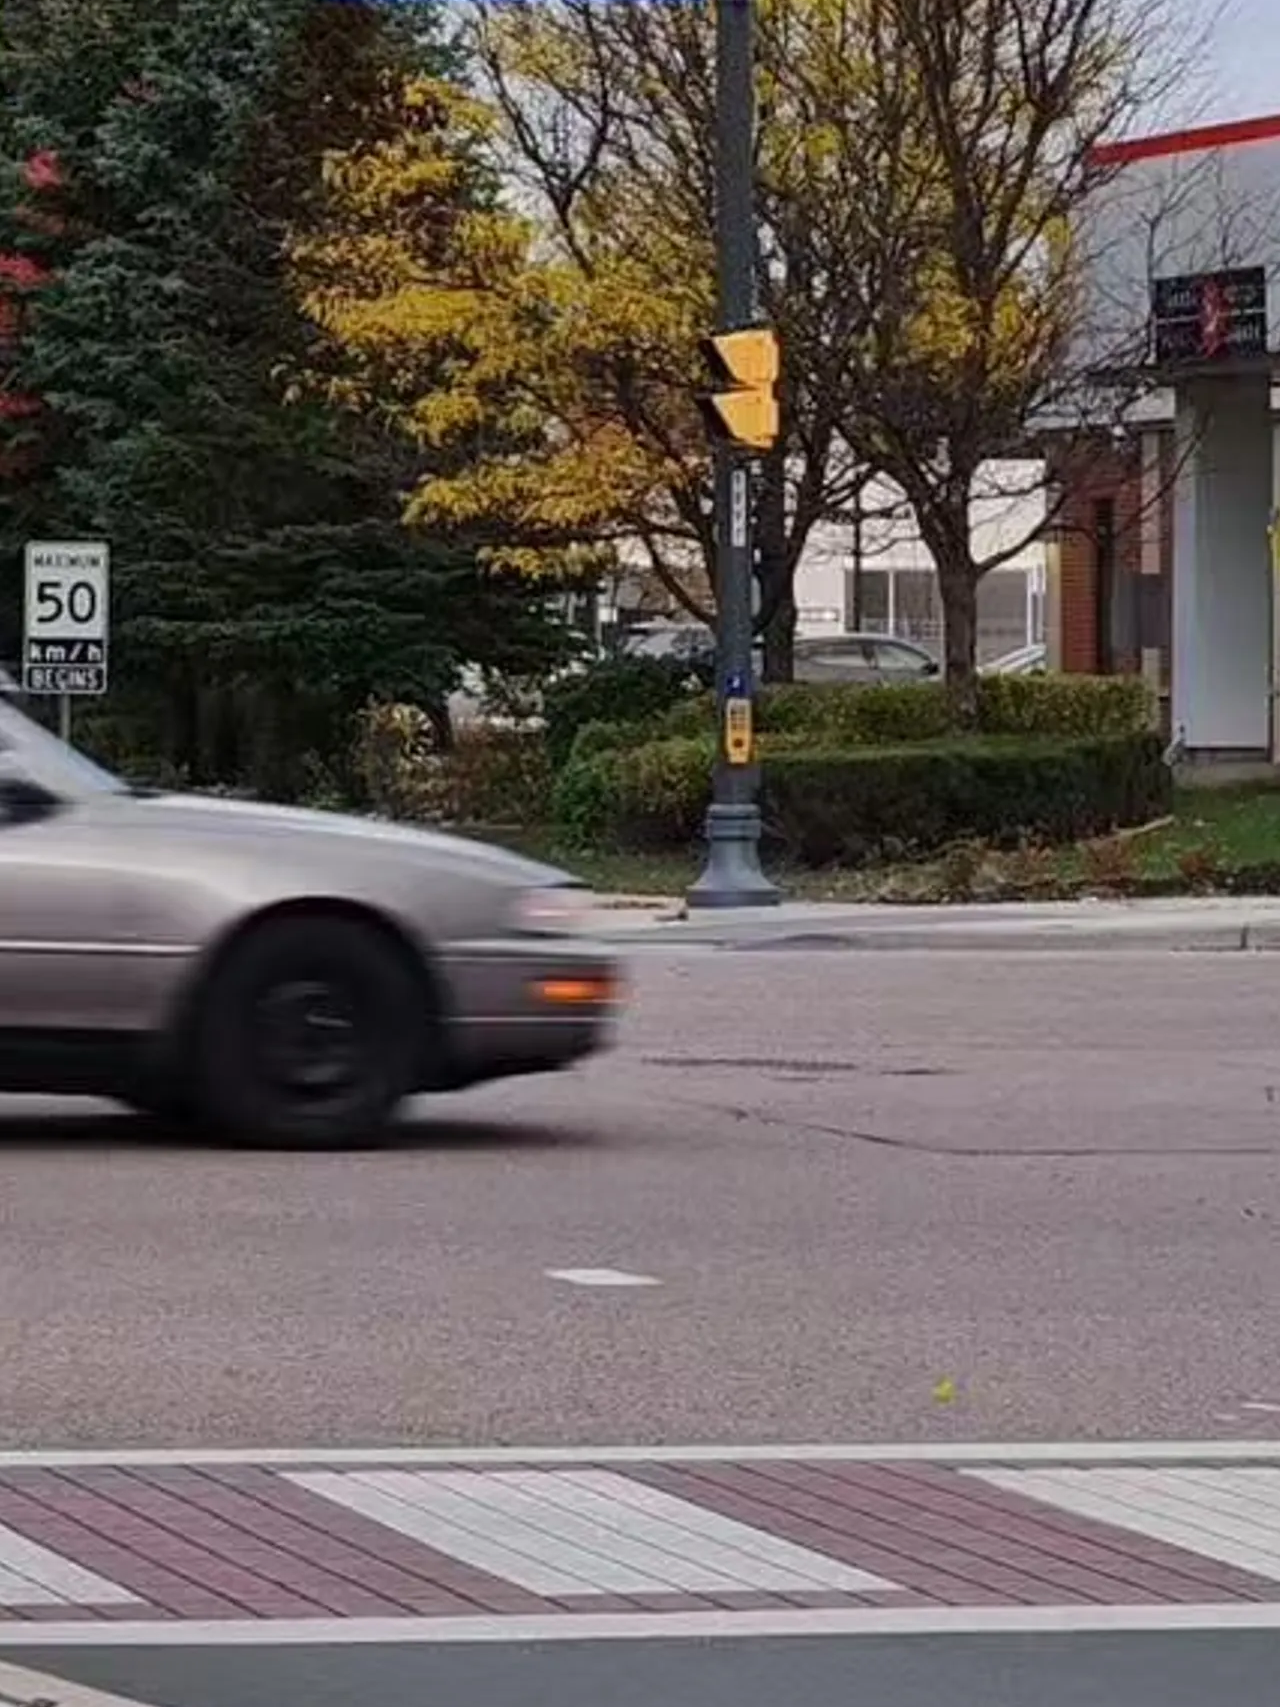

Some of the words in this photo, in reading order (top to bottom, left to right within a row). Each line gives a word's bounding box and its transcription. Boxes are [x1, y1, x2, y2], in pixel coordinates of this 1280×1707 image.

[37, 582, 96, 623] 50
[30, 642, 101, 662] km/h
[31, 668, 98, 689] BEGINS
